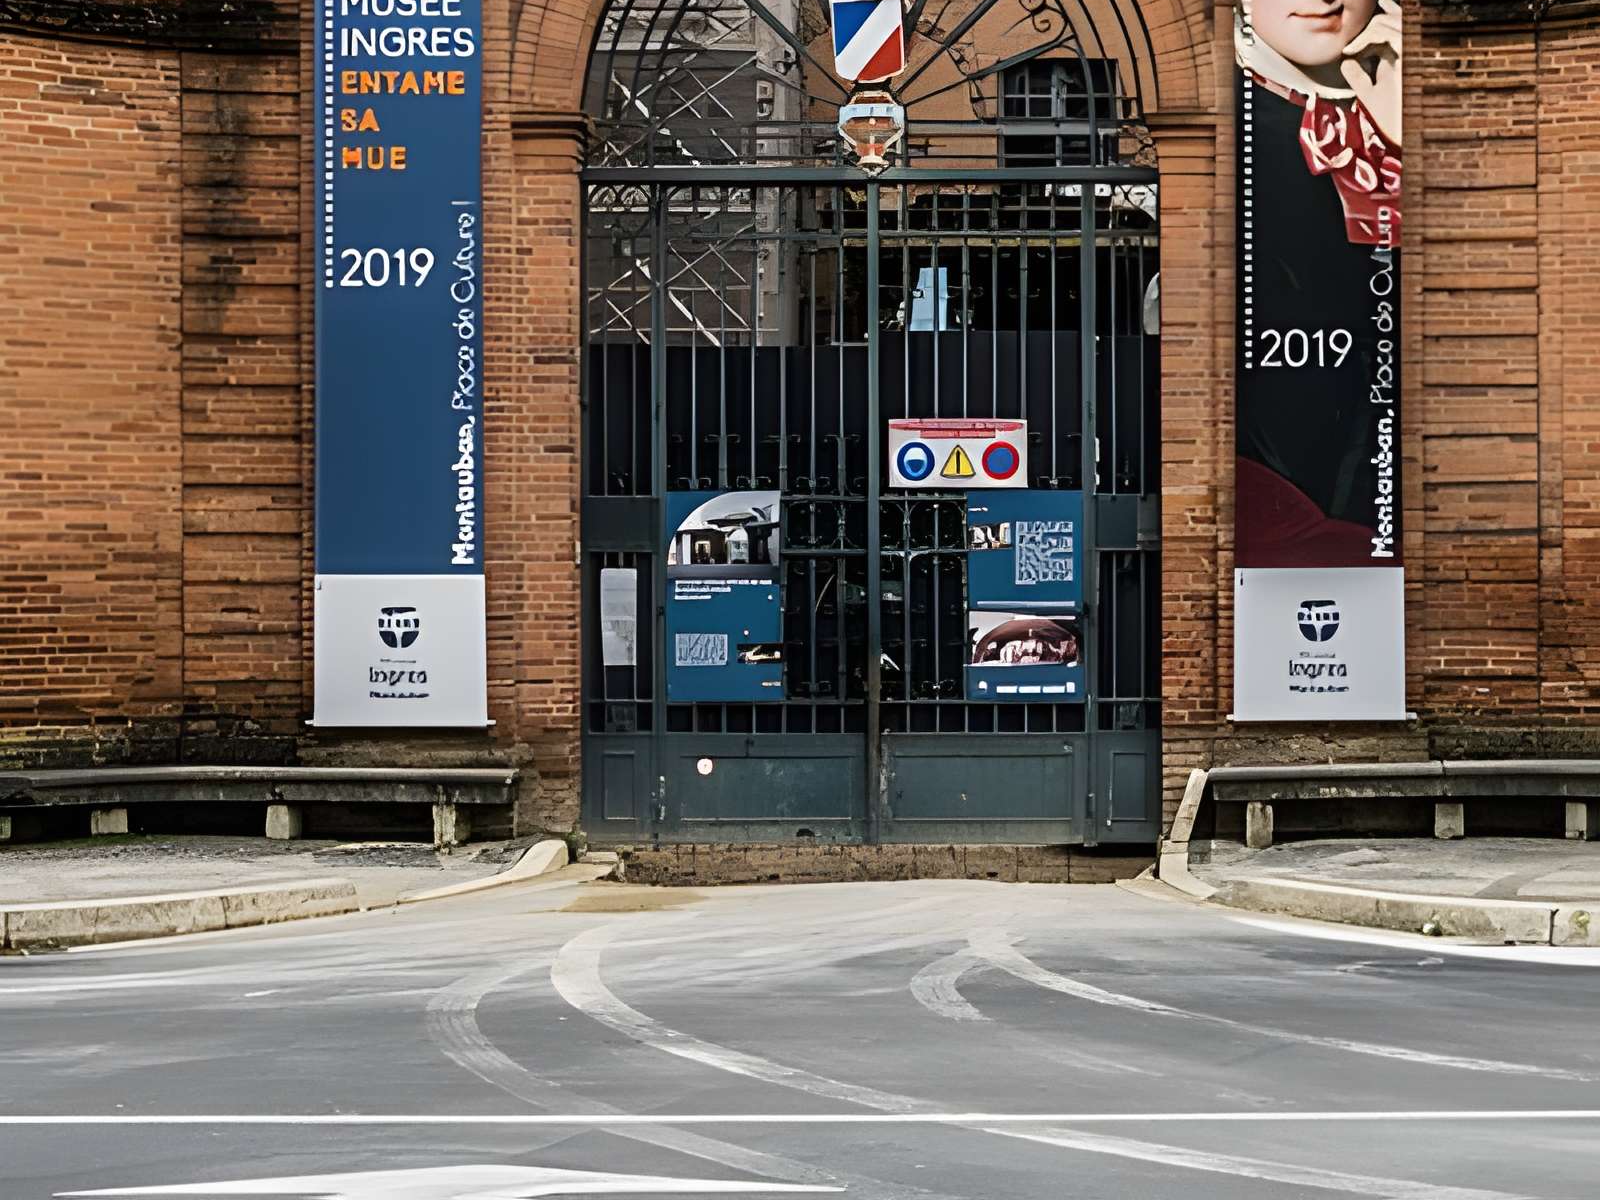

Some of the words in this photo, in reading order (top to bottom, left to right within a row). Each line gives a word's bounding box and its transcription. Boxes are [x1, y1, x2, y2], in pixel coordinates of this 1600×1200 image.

[340, 27, 475, 57] INGRES
[341, 70, 465, 95] ENTAME
[340, 108, 380, 132] SA
[340, 247, 435, 288] 2019
[1259, 328, 1353, 368] 2019
